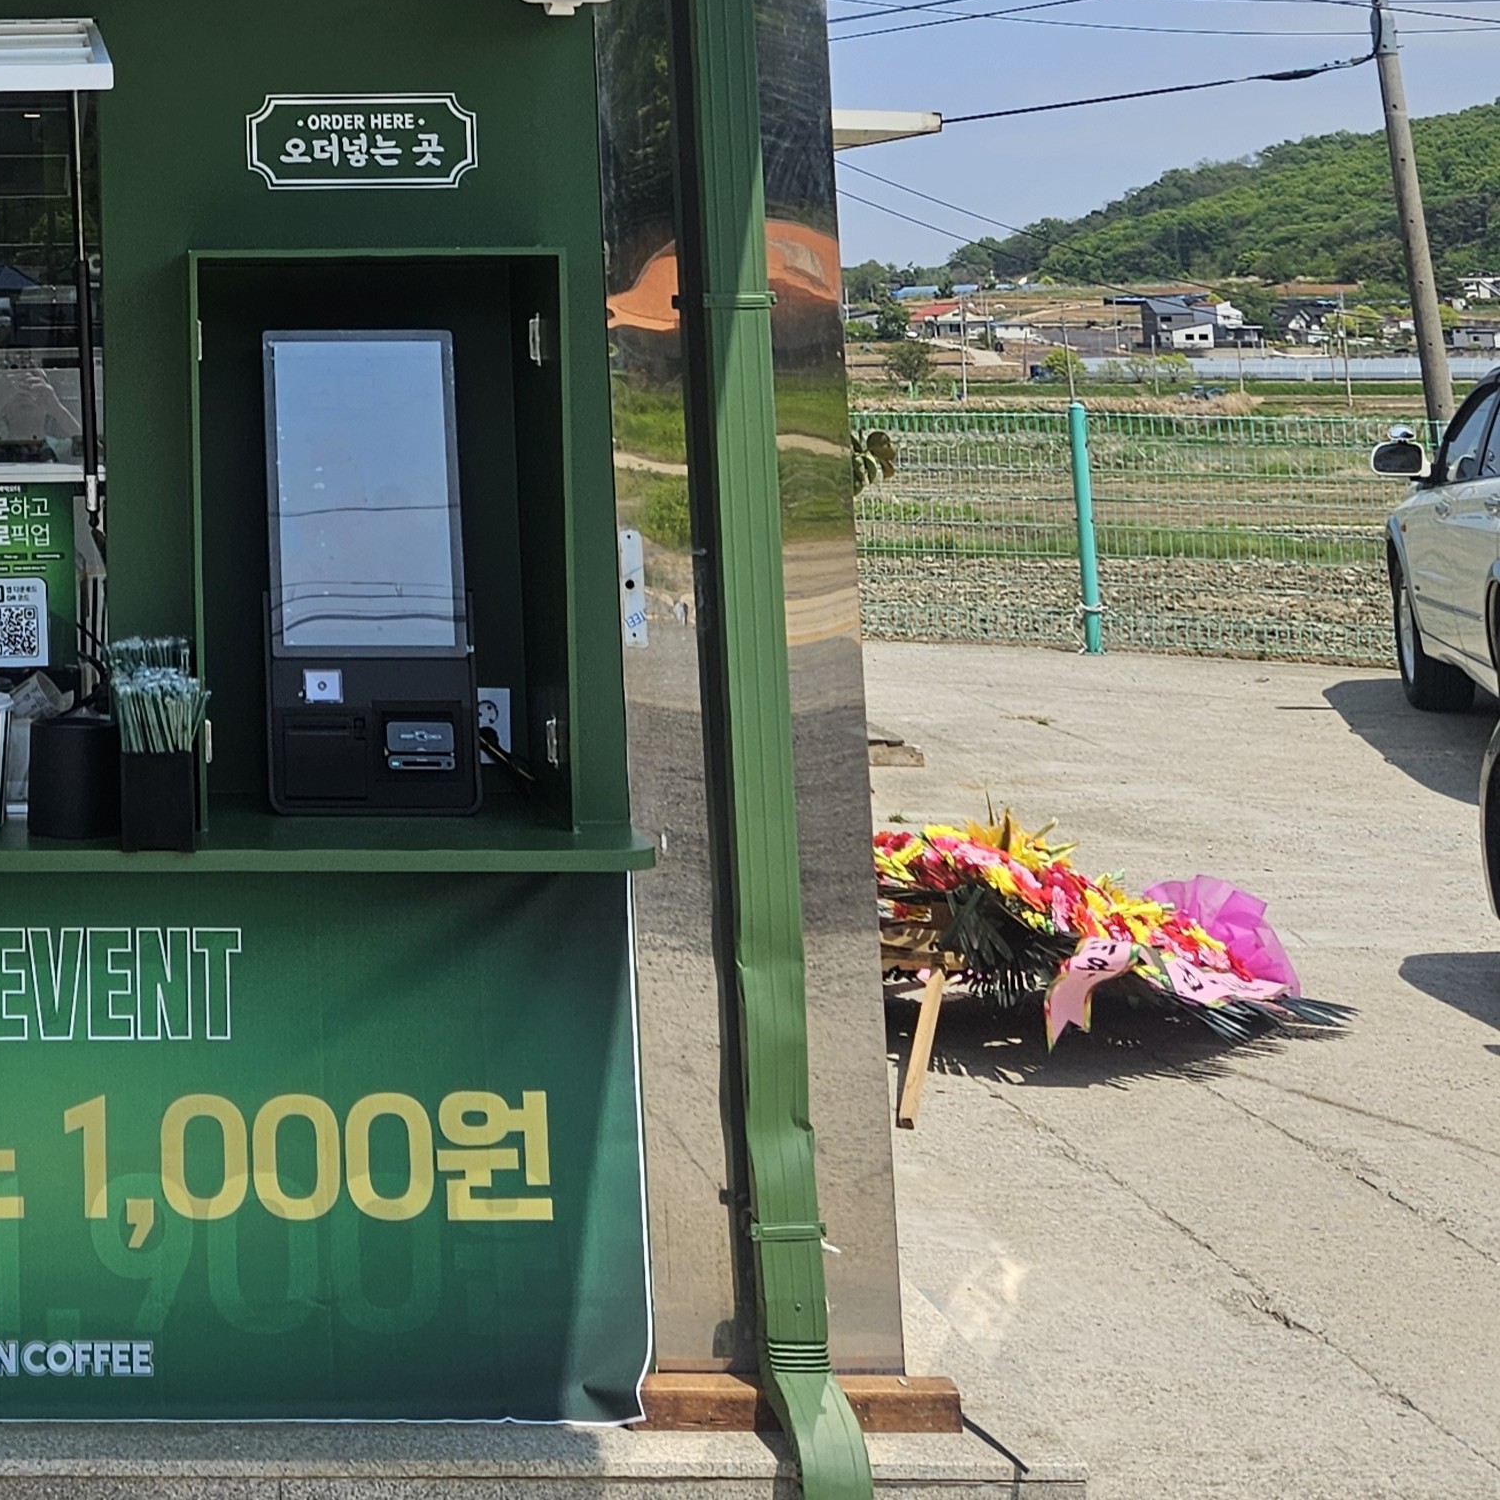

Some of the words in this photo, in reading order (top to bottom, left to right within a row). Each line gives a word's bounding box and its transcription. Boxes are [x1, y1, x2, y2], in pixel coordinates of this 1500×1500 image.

[307, 114, 365, 130] ORDER
[370, 113, 415, 130] HERE
[279, 133, 402, 168] 오더넣는
[411, 133, 445, 167] 곳
[62, 1089, 555, 1249] 1,000원
[21, 1339, 154, 1377] COFFEE
